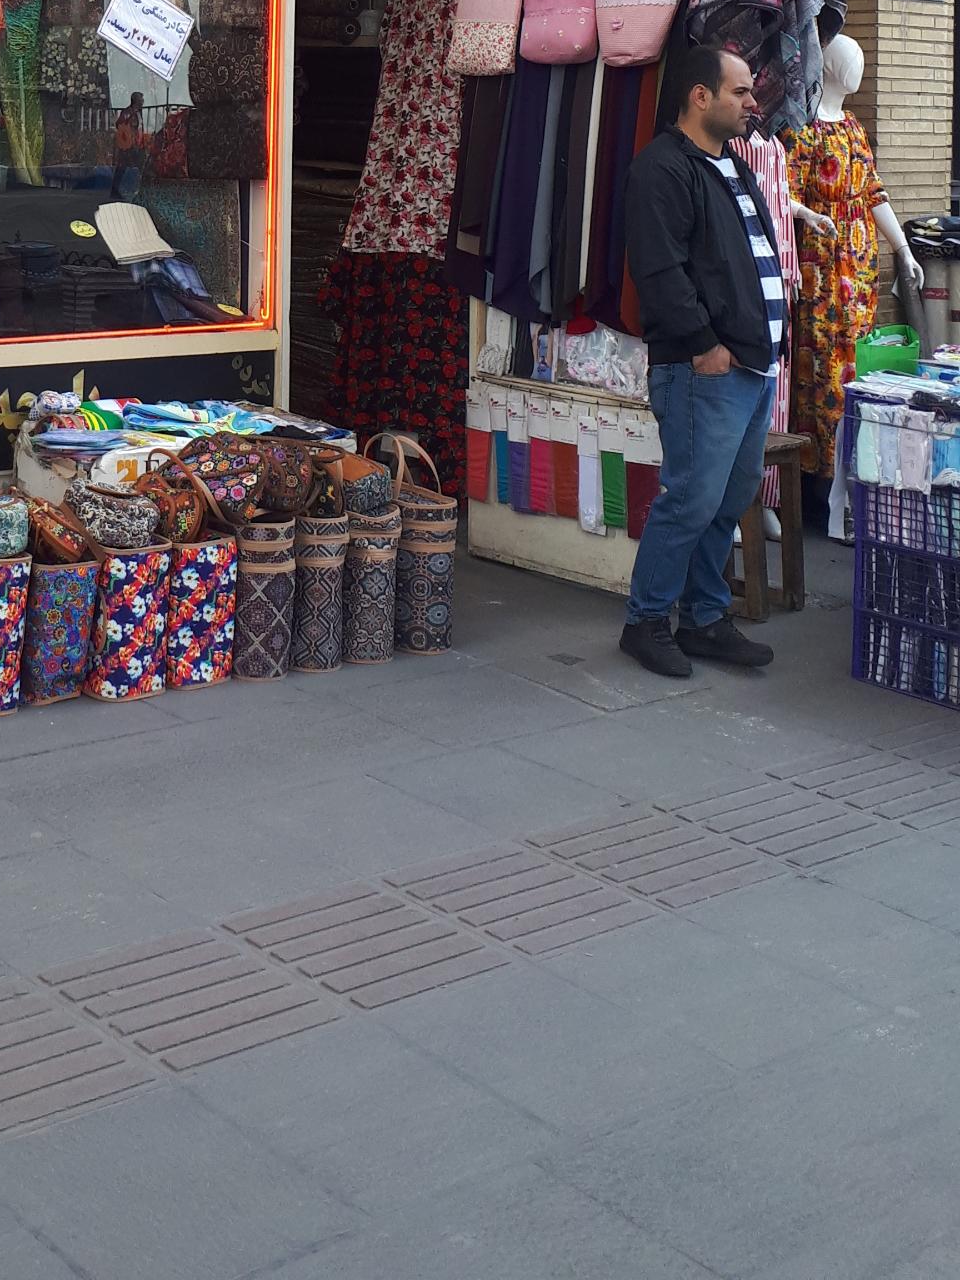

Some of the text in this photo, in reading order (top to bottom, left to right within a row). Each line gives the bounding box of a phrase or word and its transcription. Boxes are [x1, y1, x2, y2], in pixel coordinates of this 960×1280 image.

[141, 5, 168, 24] مشکی
[166, 21, 186, 38] چادر
[154, 47, 172, 65] مدل
